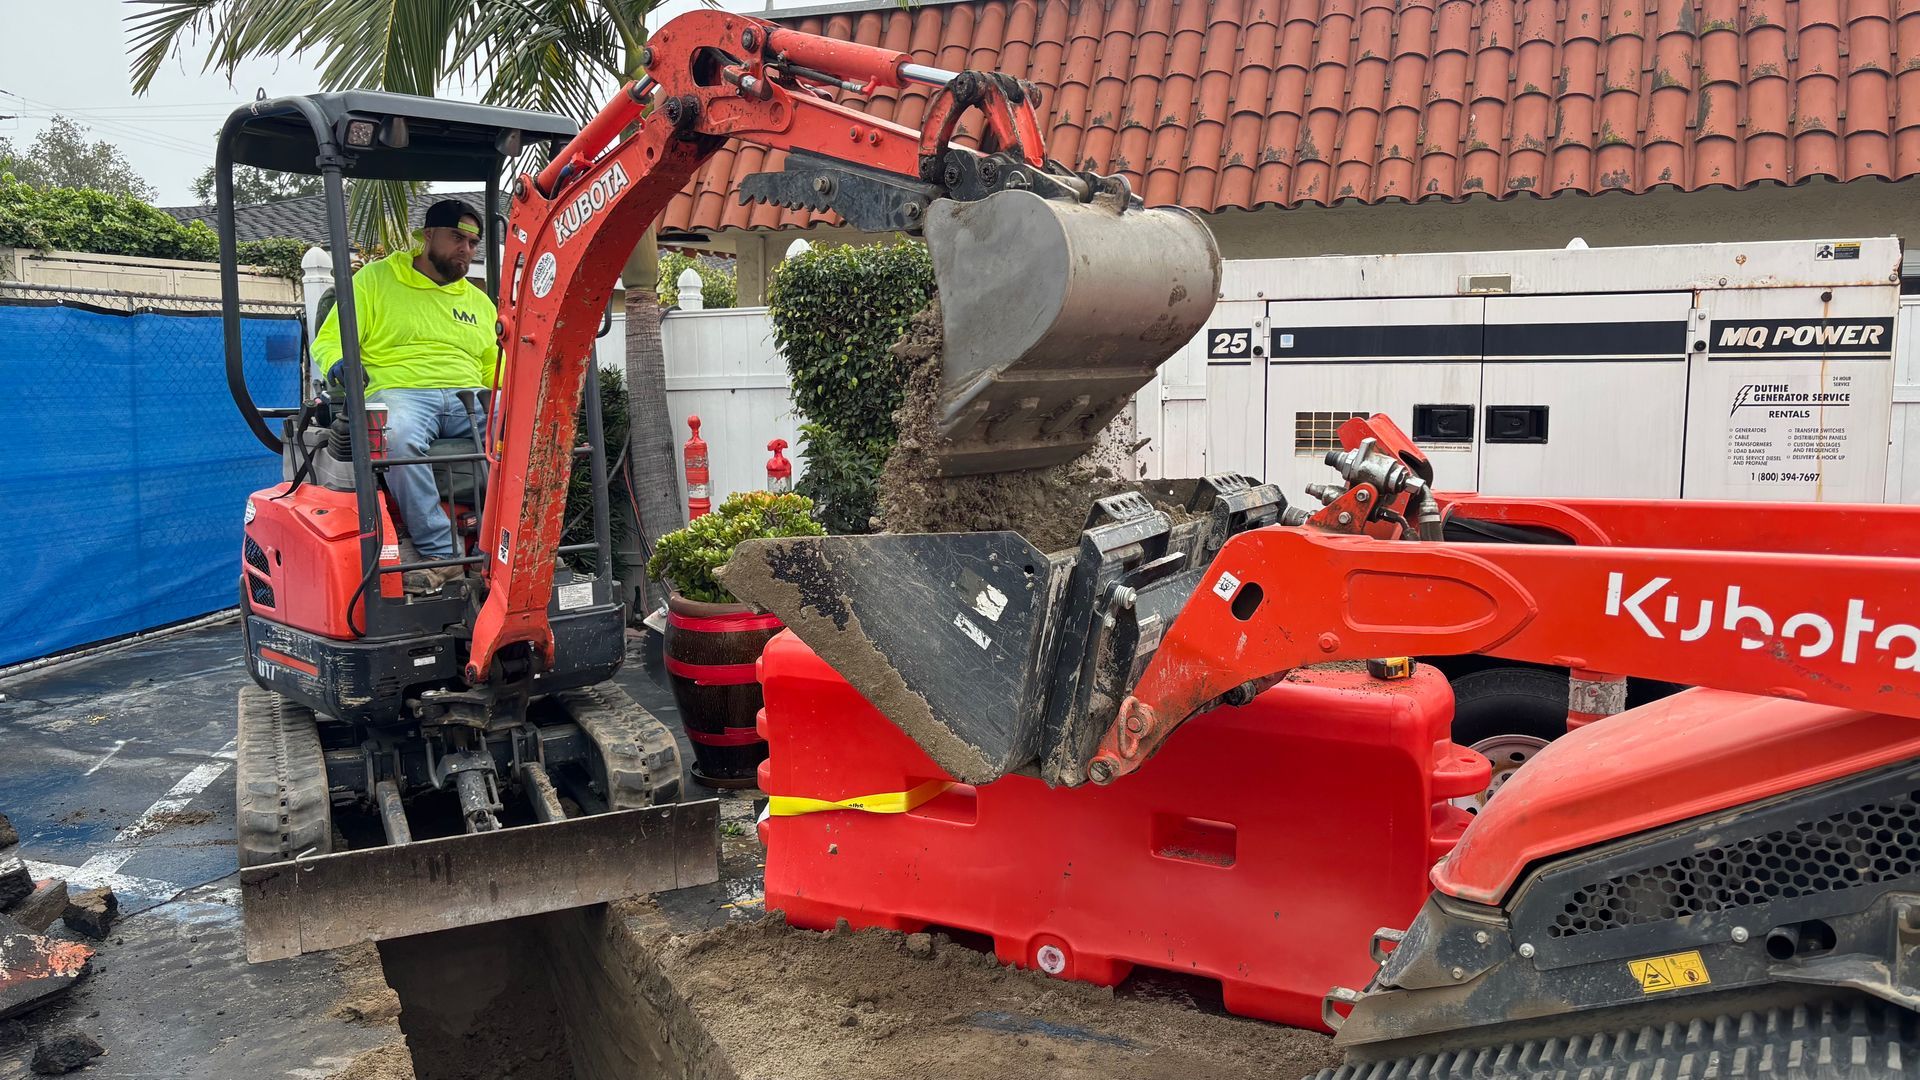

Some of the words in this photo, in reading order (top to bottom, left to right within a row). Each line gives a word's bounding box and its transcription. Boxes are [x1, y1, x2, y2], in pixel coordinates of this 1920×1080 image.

[553, 161, 630, 246] KUBOTA
[453, 308, 477, 325] MM
[1212, 332, 1249, 354] 25
[1718, 327, 1769, 349] MQ
[1771, 325, 1885, 346] POWER
[1754, 384, 1789, 392] DUTHIE
[1754, 393, 1809, 402] GENERATOR
[1812, 393, 1850, 402] SERVICE
[1768, 410, 1810, 418] RENTALS
[1758, 472, 1779, 482] (800)
[1780, 472, 1820, 481] 394-7697
[1605, 571, 1920, 672] Kubota
